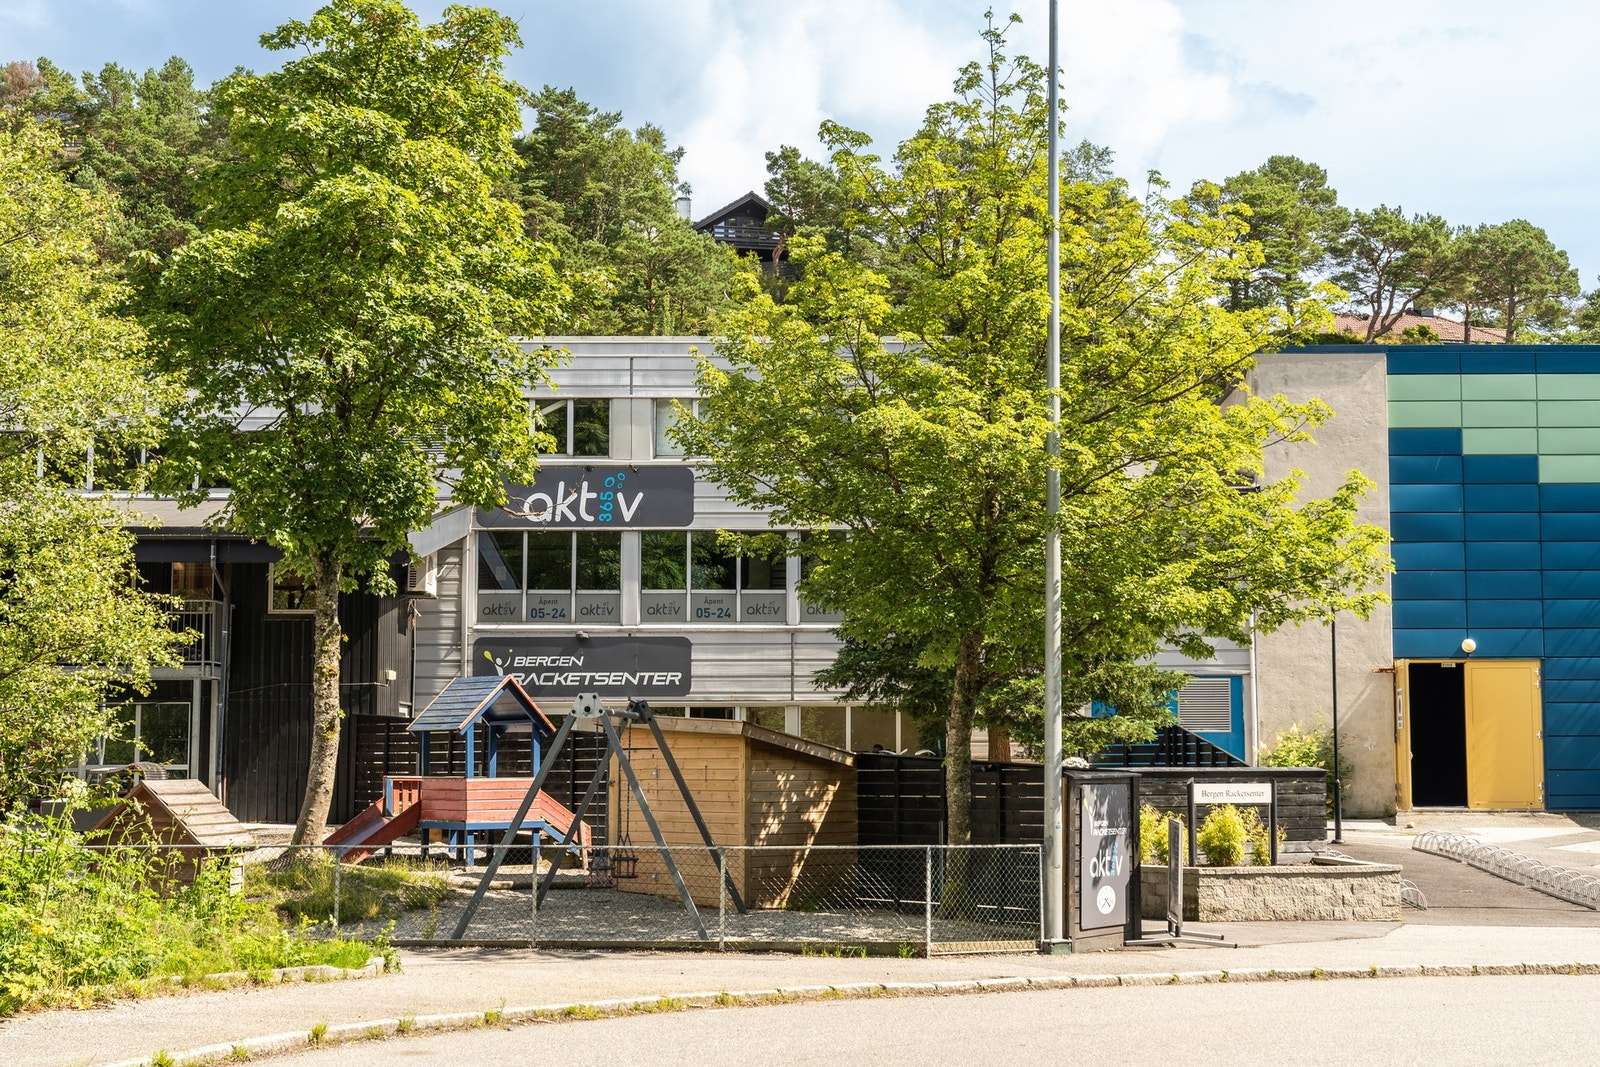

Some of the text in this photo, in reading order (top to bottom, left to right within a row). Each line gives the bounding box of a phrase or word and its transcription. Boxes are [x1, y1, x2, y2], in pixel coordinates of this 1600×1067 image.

[704, 597, 724, 605] Åpent
[530, 607, 566, 619] 05-24
[696, 607, 731, 619] 05-24
[514, 656, 584, 667] BERGEN
[513, 672, 681, 686] RACKETSENTER
[1201, 790, 1224, 799] Bergen
